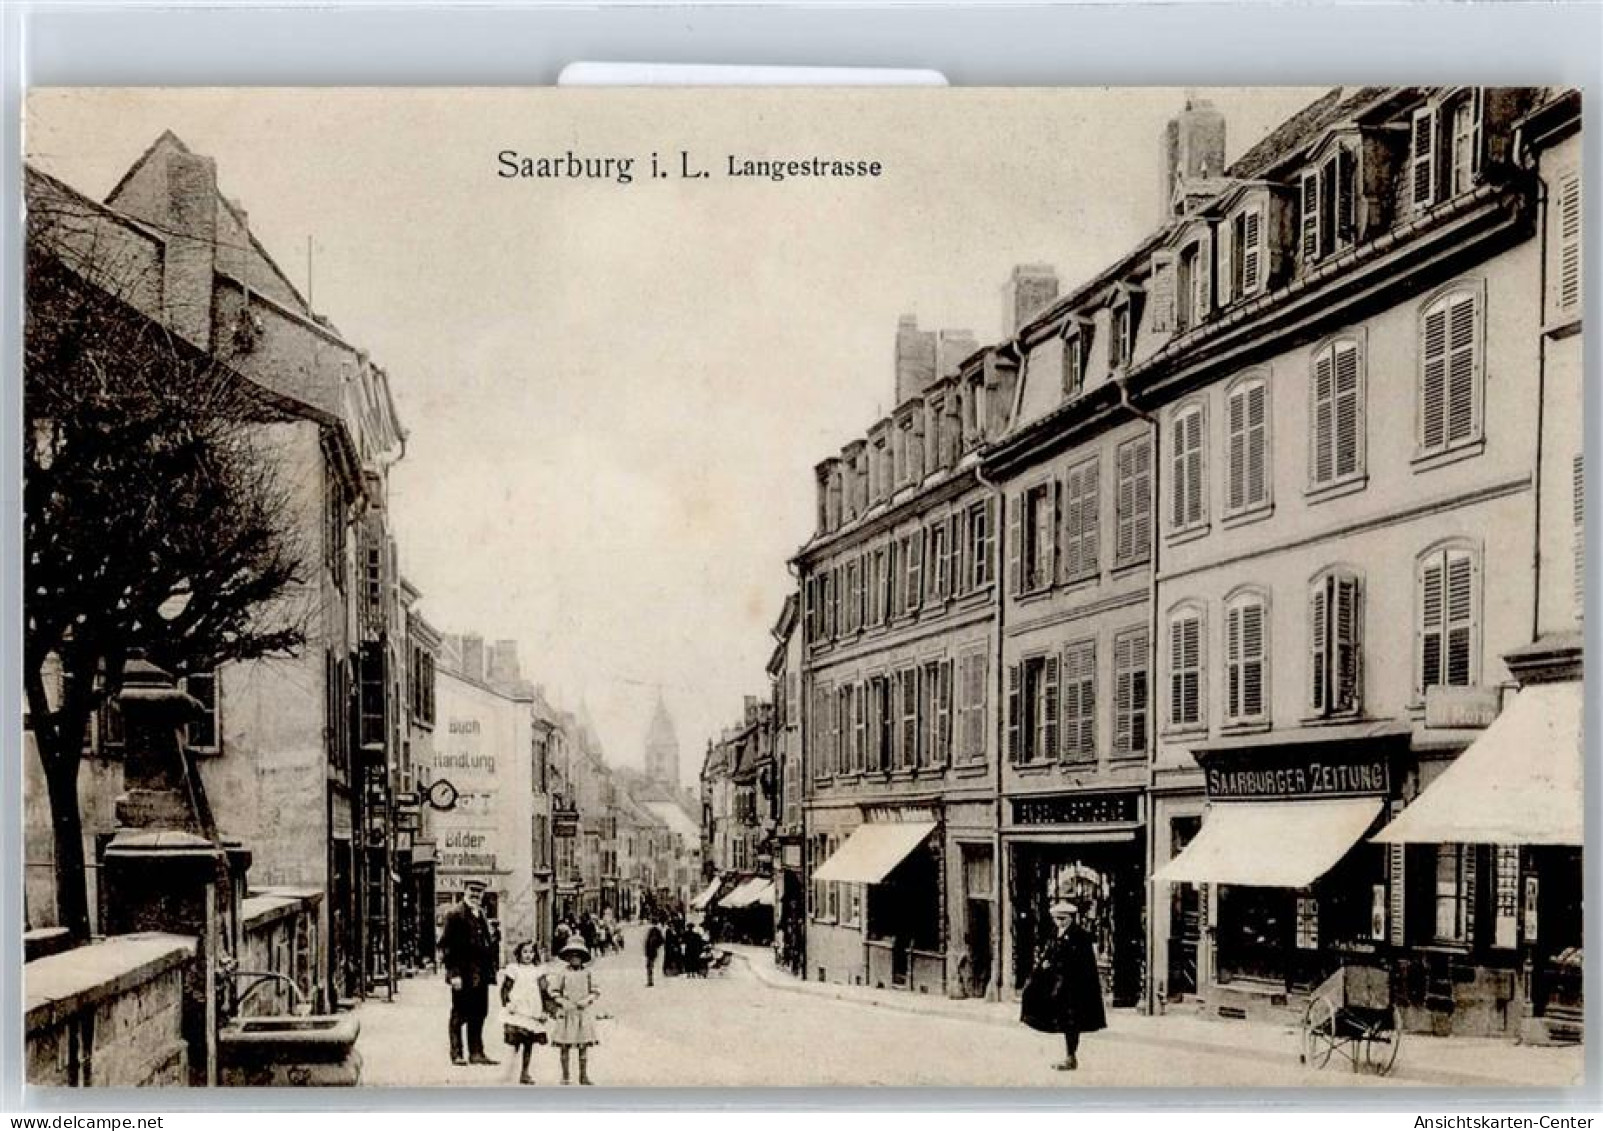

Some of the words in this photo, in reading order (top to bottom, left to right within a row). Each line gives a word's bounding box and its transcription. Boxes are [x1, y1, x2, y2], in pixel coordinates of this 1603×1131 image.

[1208, 768, 1306, 795] SAARBURGER
[1309, 762, 1383, 792] ZEITUNG
[445, 830, 486, 849] Bilder
